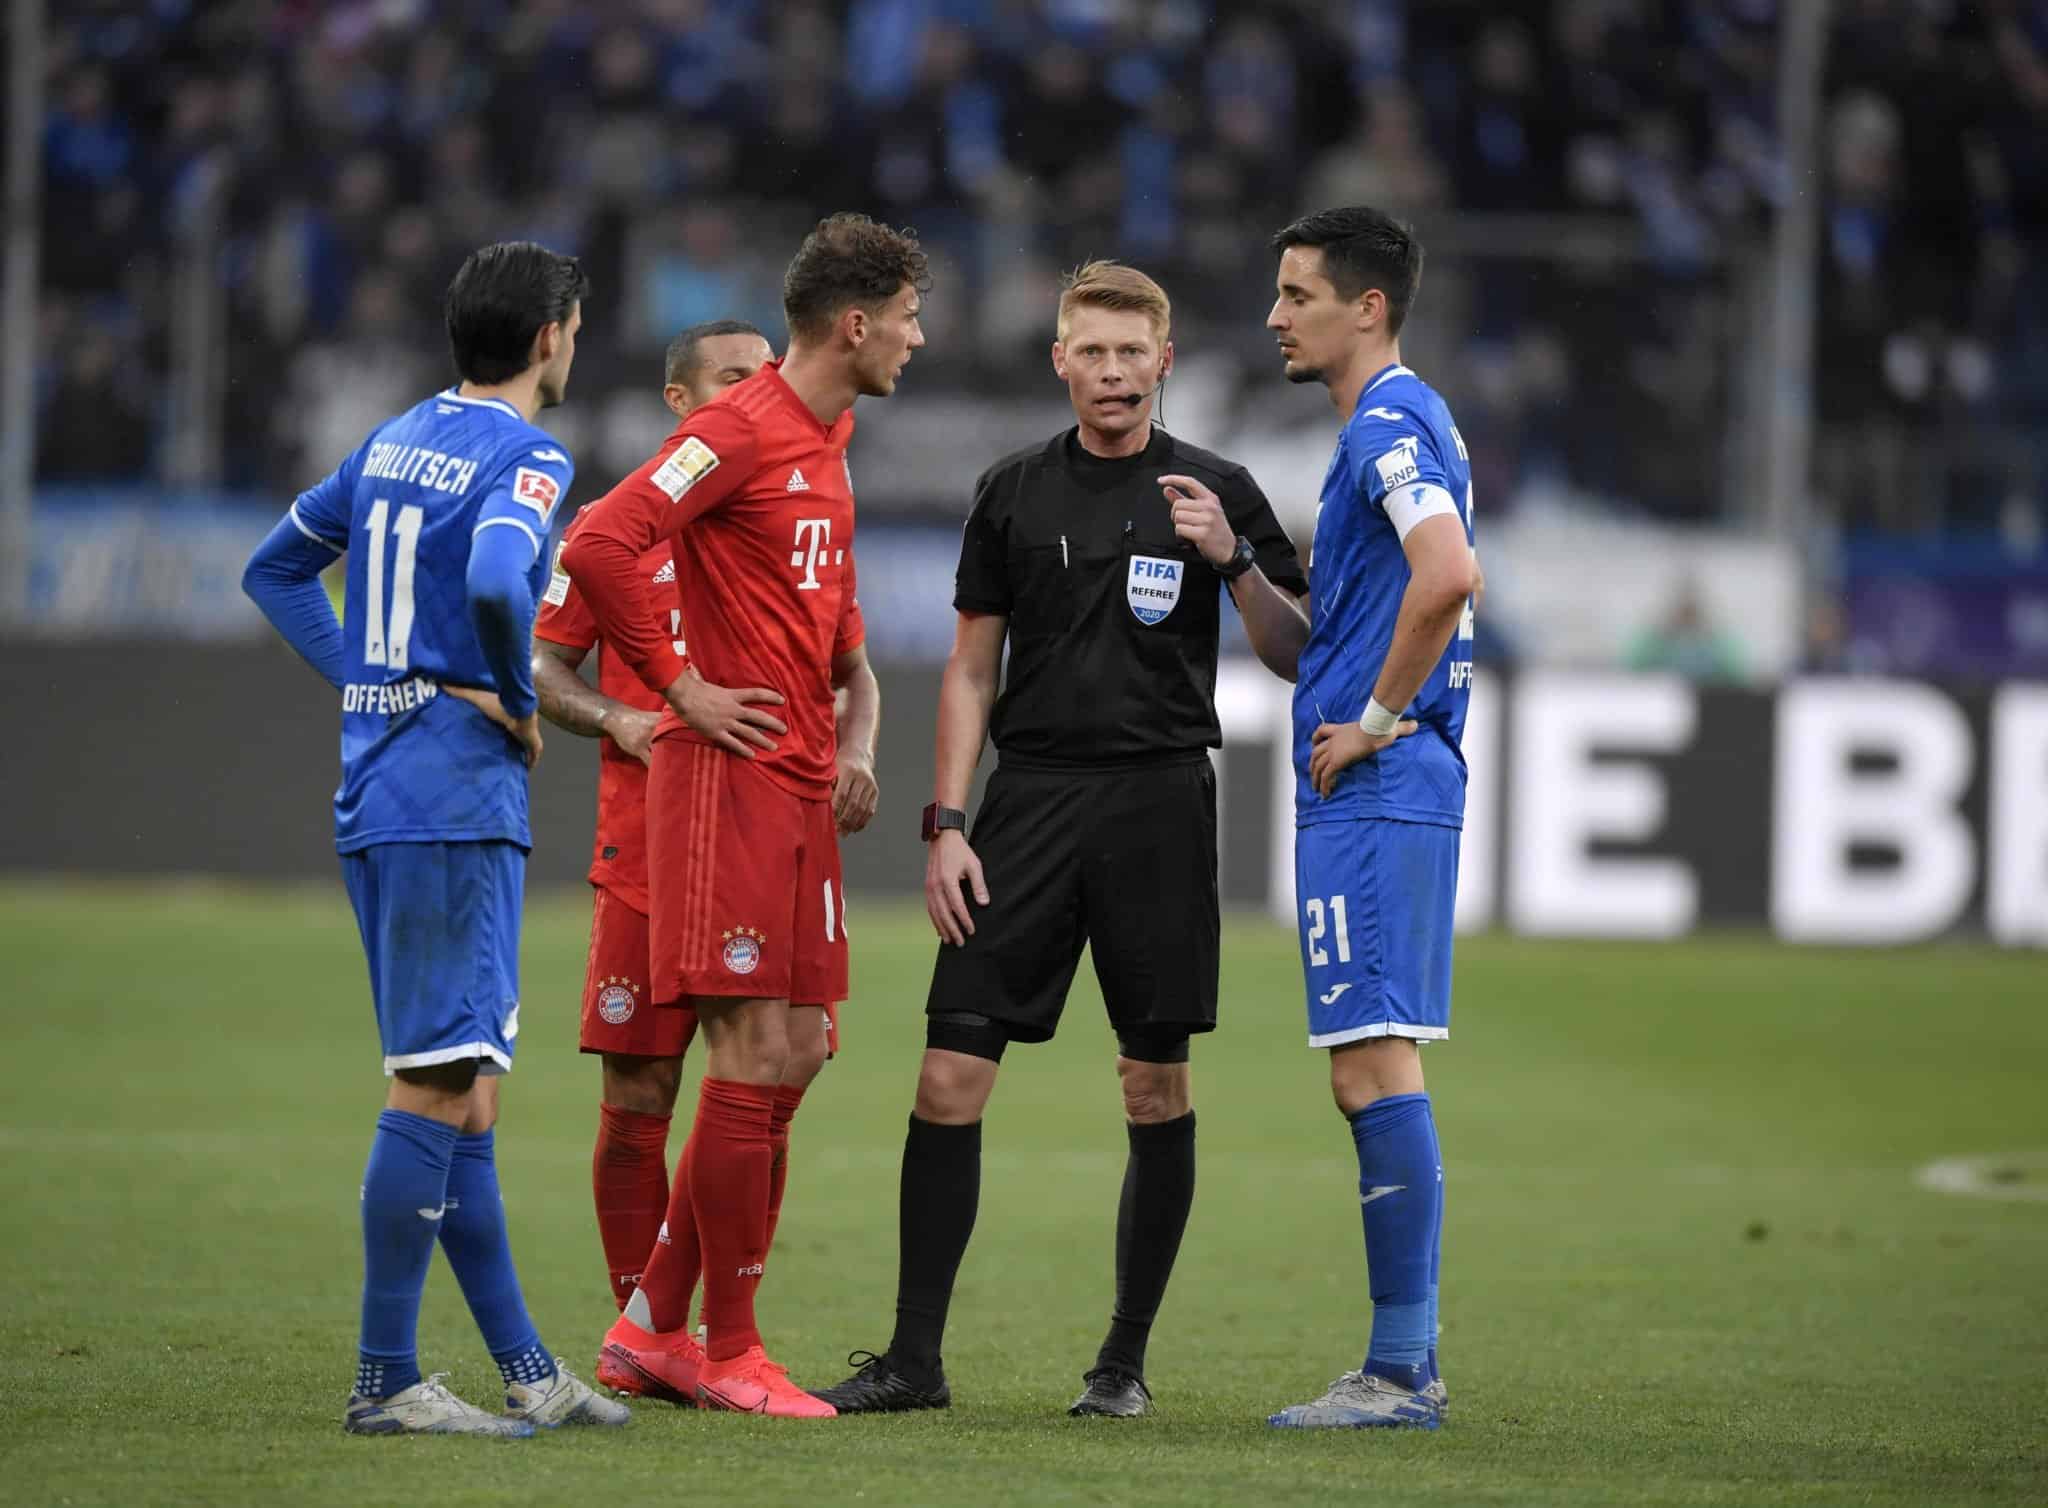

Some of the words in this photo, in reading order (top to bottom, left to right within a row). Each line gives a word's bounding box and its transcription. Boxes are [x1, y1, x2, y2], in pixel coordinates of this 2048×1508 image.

[362, 443, 478, 496] GRILLITSCH
[1385, 465, 1416, 489] SNP
[1134, 560, 1177, 581] FIFA
[364, 499, 424, 671] 11
[1131, 586, 1175, 601] REFEREE
[1140, 609, 1160, 619] 2020
[1306, 894, 1351, 967] 21
[736, 1263, 763, 1278] FCB
